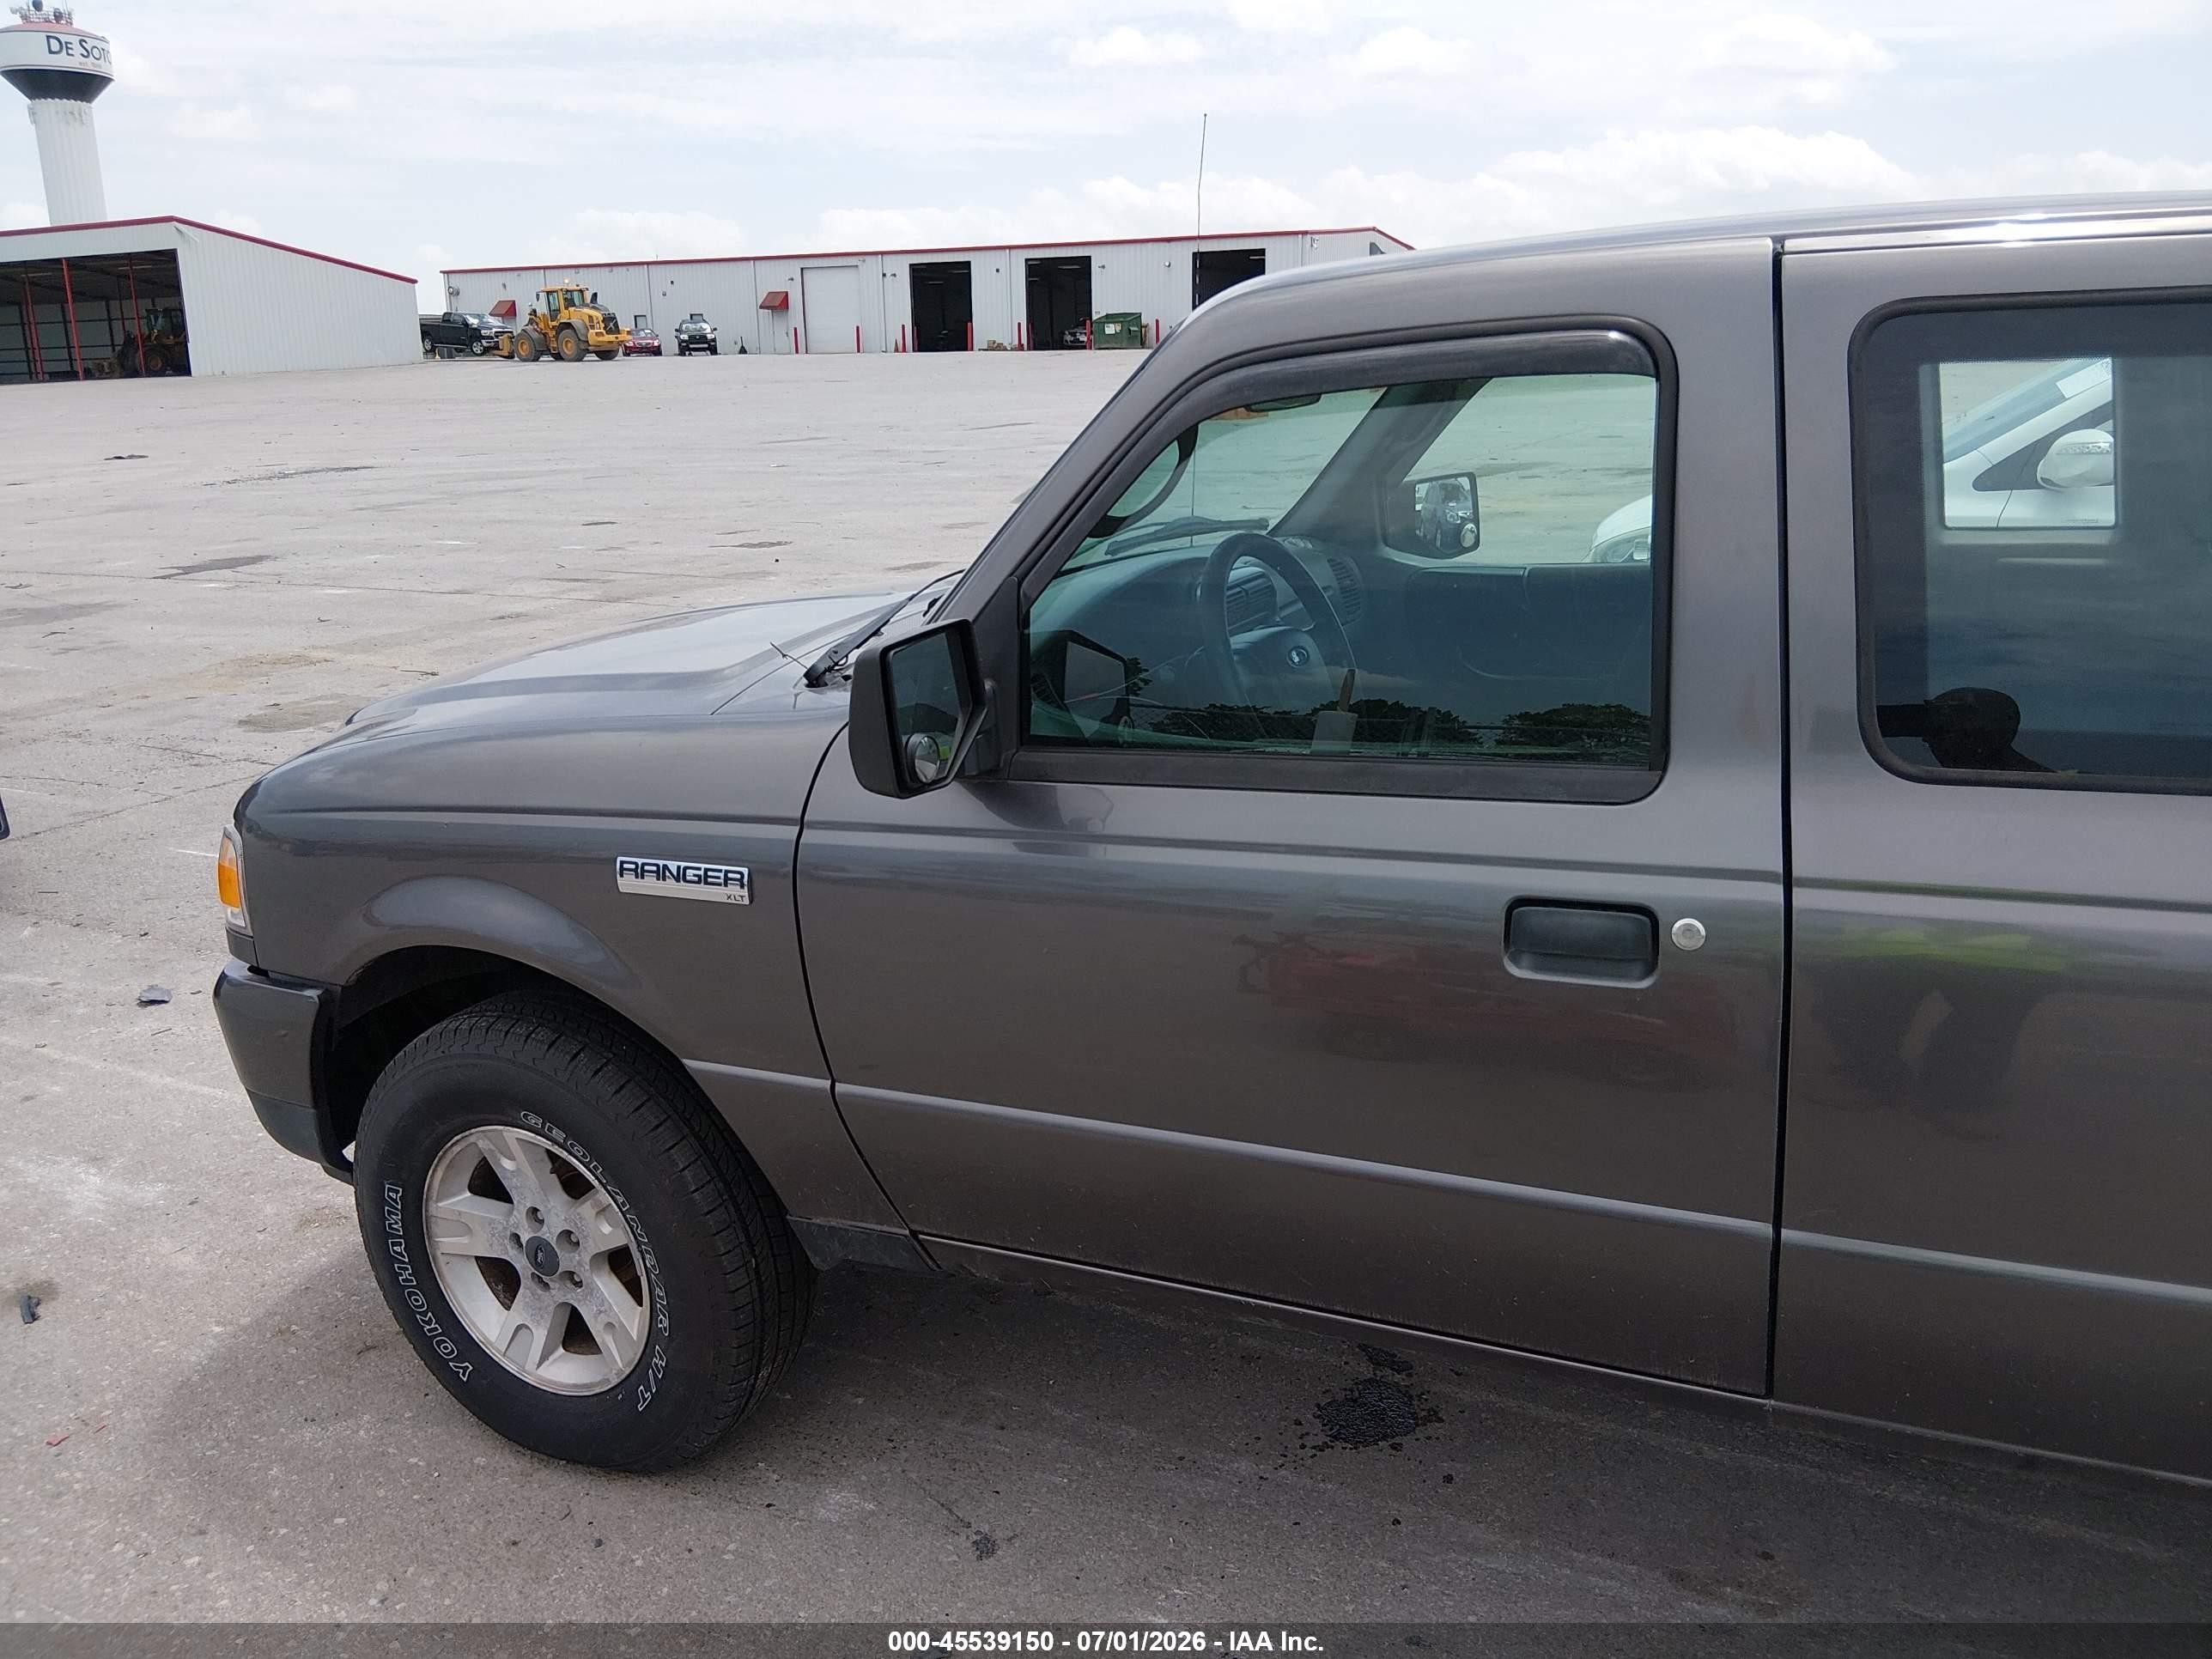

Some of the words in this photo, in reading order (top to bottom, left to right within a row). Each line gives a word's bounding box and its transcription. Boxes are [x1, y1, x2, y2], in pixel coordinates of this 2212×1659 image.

[618, 860, 745, 890] RANGER
[726, 892, 746, 902] XLT
[520, 1111, 669, 1336] GEOLANDAR
[385, 1184, 473, 1382] YOKOHAMA
